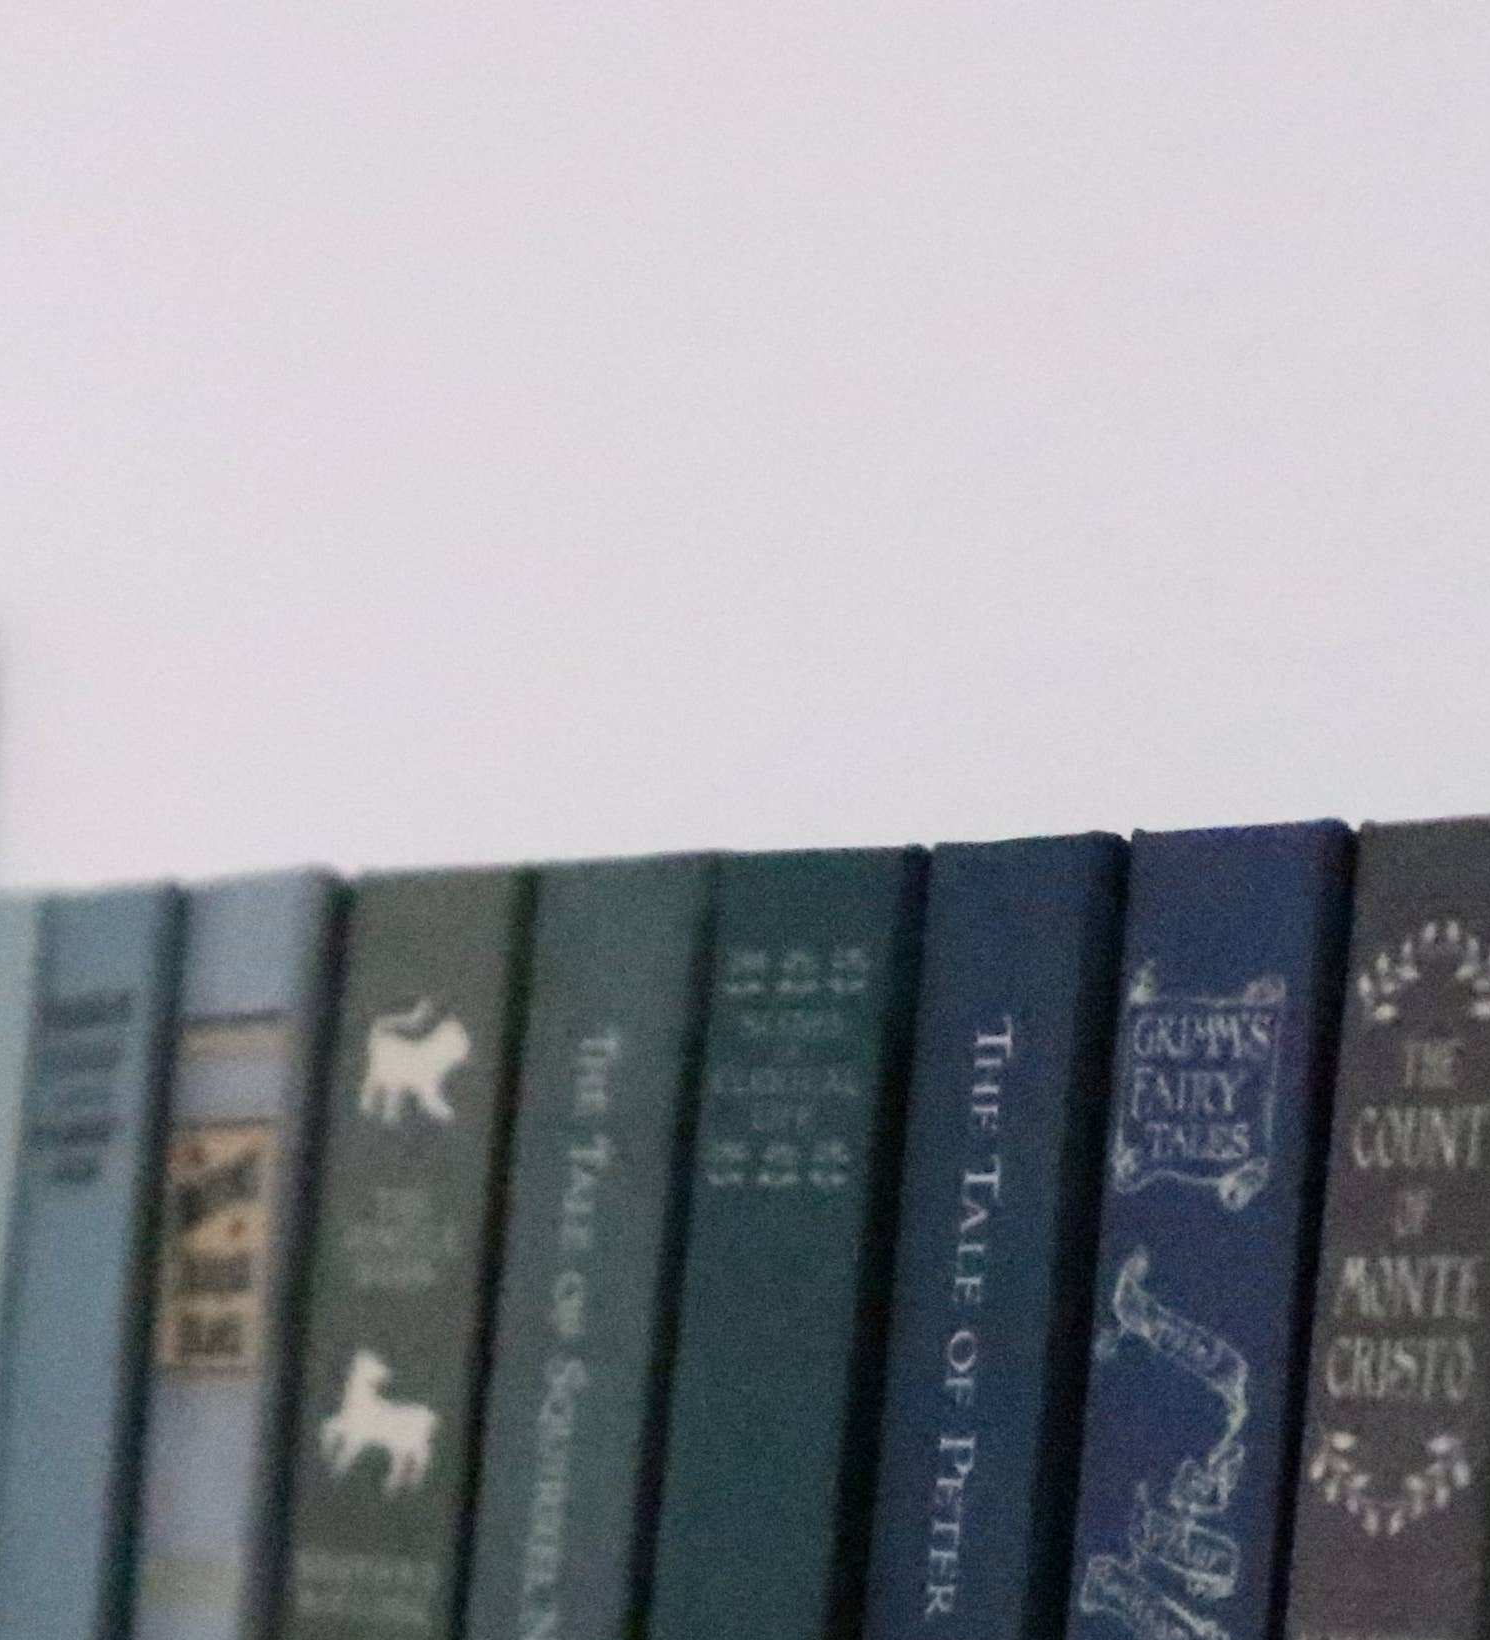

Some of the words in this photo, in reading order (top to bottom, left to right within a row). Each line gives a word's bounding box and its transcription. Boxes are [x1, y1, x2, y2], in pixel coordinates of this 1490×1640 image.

[970, 1014, 1014, 1131] THE
[1131, 1066, 1247, 1117] FAIRY
[1145, 1122, 1250, 1160] TALES
[1353, 1104, 1490, 1168] COUNT
[953, 1157, 1003, 1304] TALE
[1333, 1256, 1483, 1318] MONTE
[944, 1330, 977, 1404] OF
[1326, 1336, 1473, 1401] CRISTO
[923, 1434, 975, 1615] PETER
